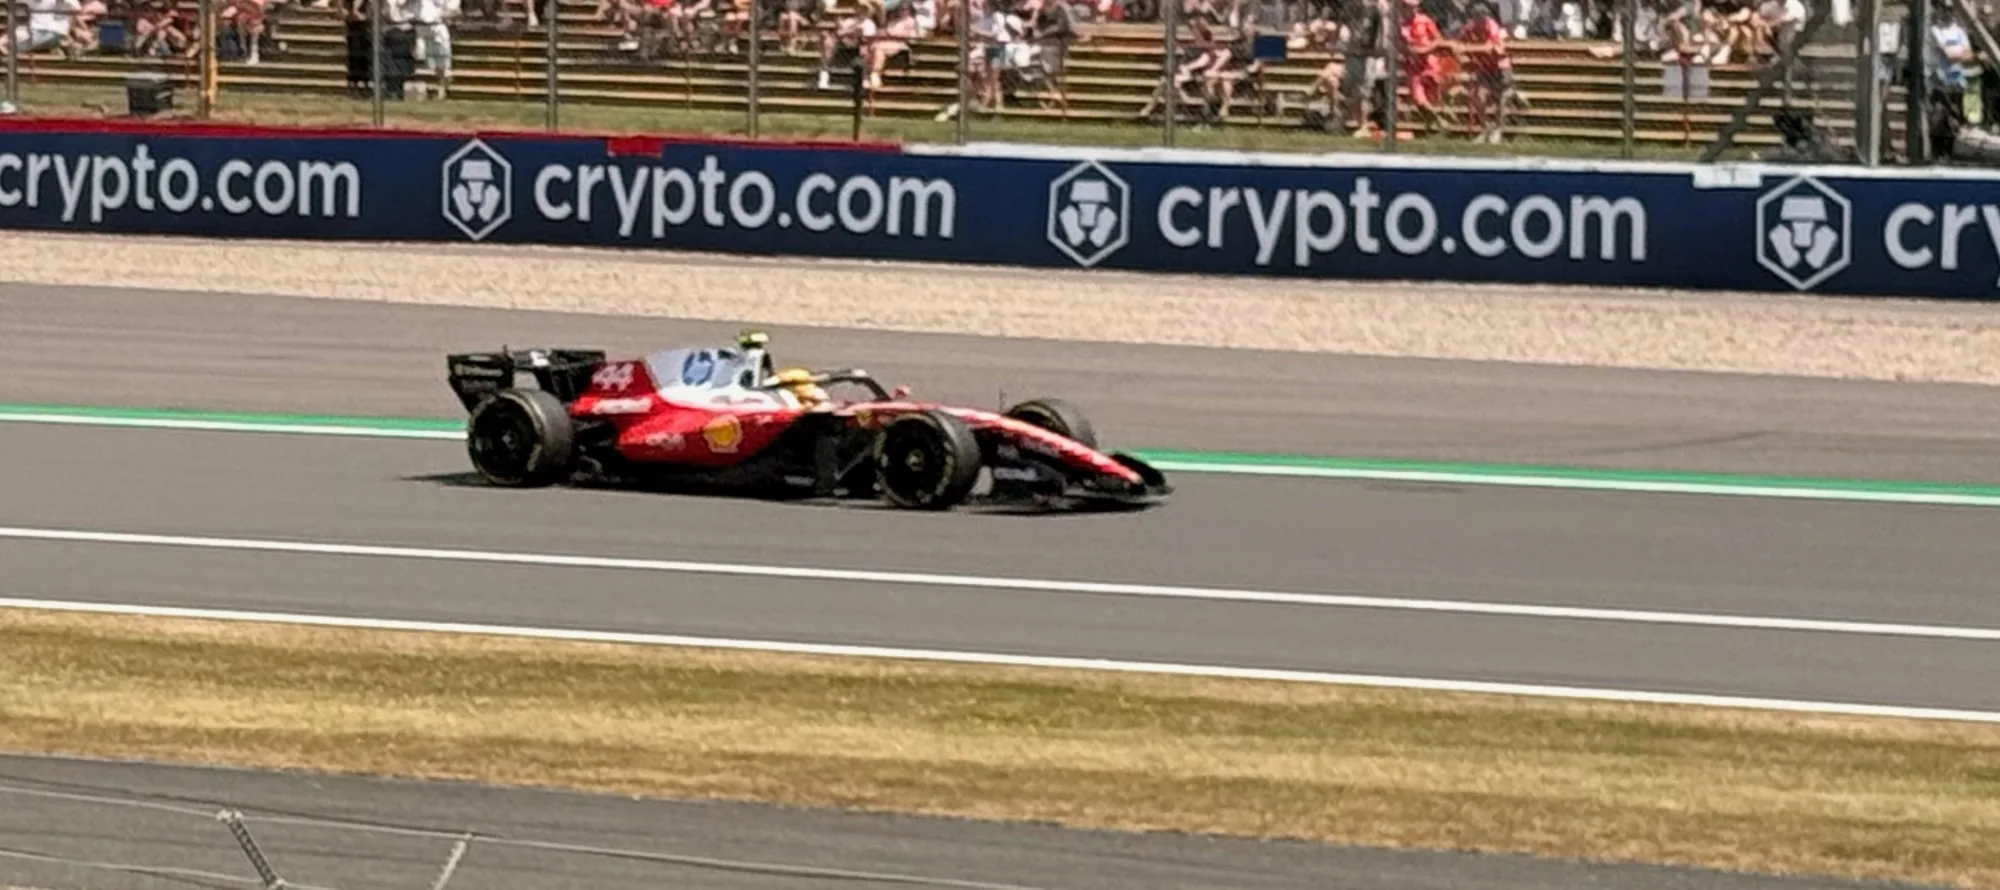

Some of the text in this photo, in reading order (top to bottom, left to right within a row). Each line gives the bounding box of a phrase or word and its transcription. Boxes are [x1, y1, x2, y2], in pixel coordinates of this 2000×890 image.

[0, 144, 359, 222] crypto.com
[535, 156, 955, 238] crypto.com
[1158, 178, 1645, 266] crypto.com
[592, 363, 635, 392] 44
